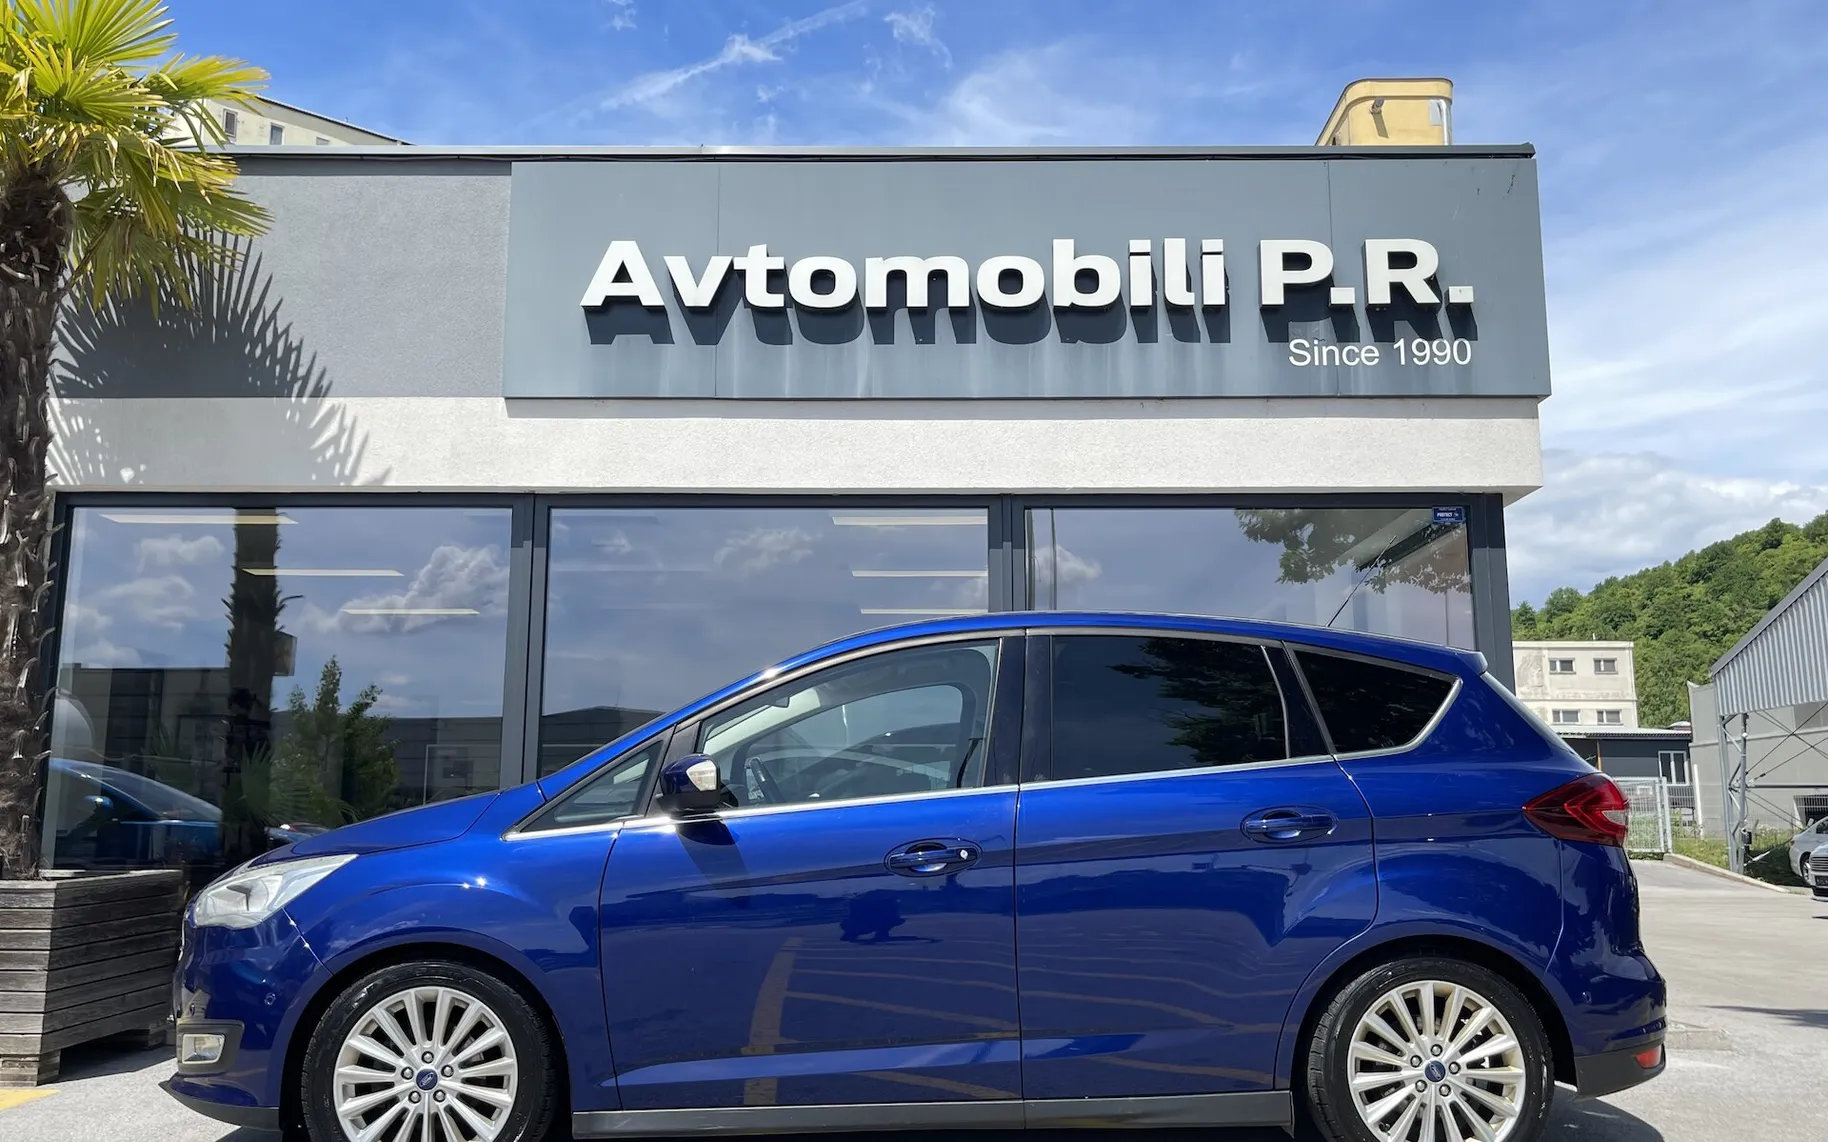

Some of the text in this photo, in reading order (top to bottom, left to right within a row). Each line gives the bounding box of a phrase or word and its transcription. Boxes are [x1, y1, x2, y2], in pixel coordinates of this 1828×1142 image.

[580, 238, 1475, 309] Avtomobili P.R.
[1288, 337, 1472, 367] Since 1990
